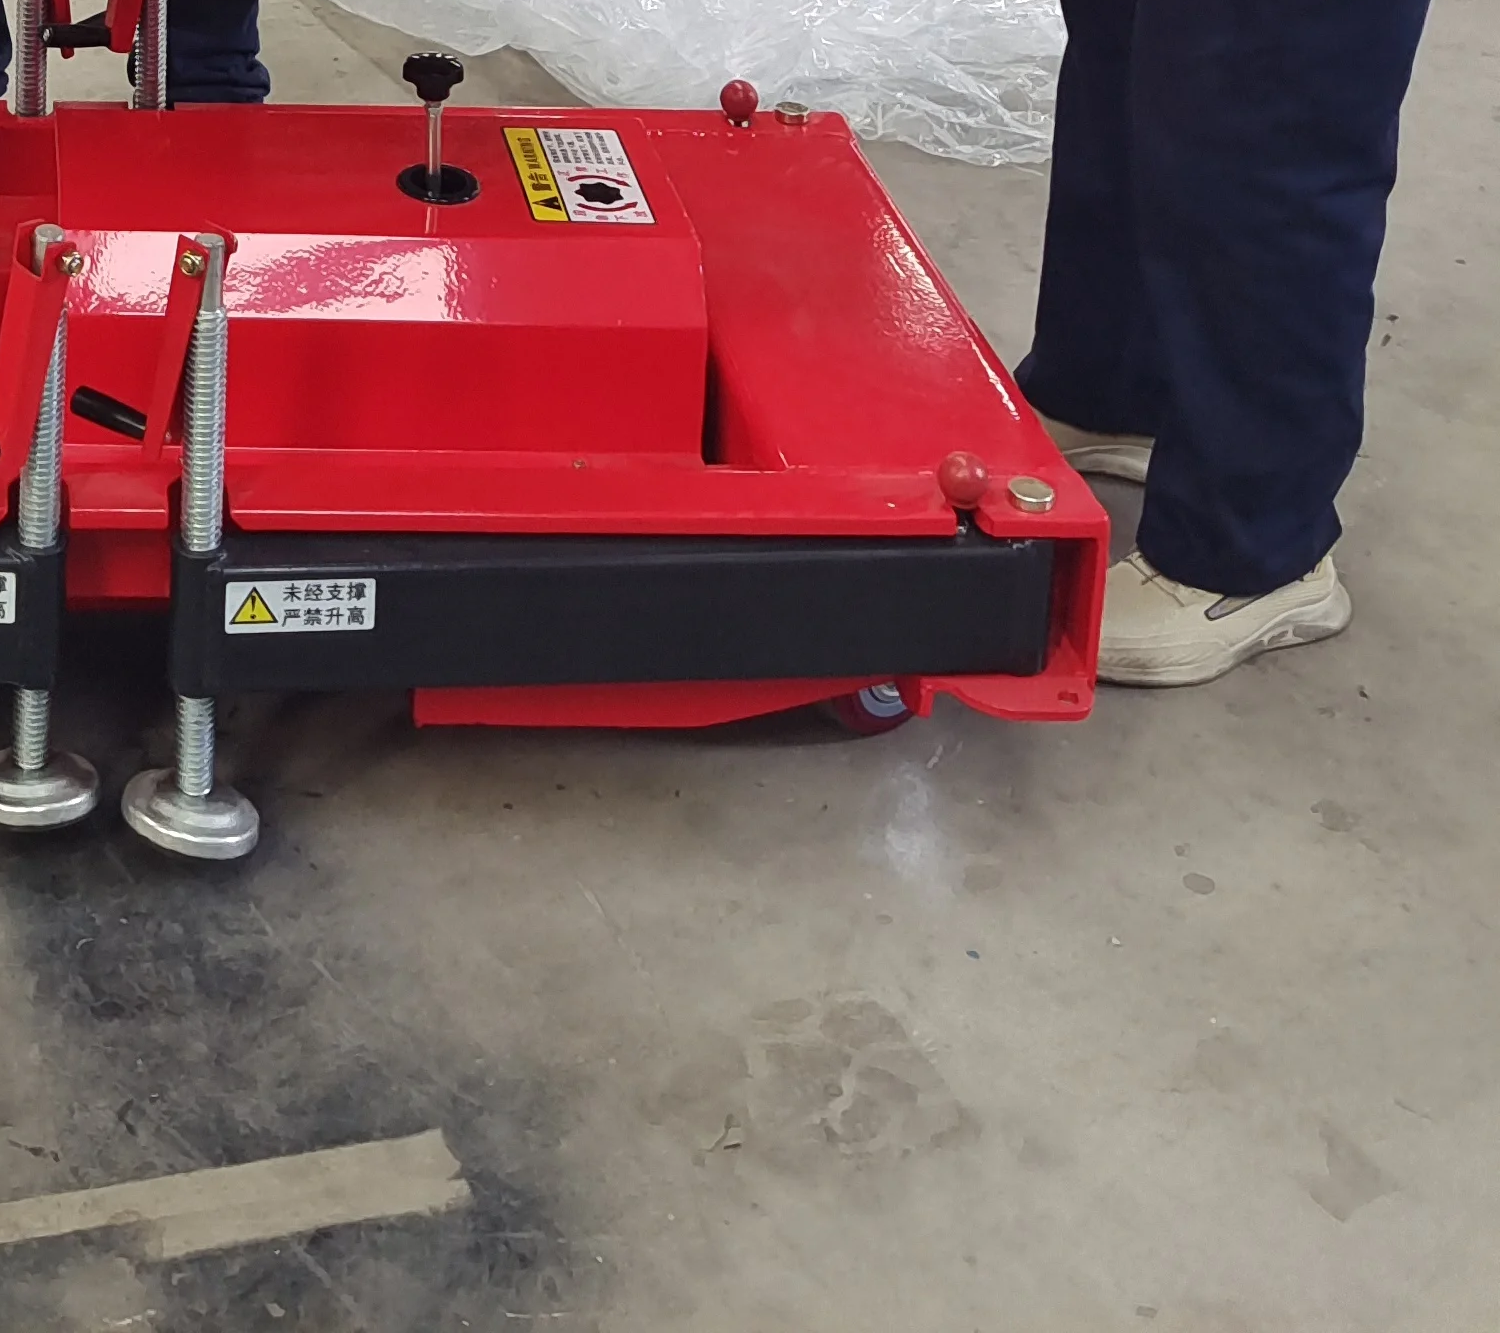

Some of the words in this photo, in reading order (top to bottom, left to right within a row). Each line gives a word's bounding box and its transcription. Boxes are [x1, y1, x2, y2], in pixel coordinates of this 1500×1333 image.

[281, 582, 368, 603] 未经支撑
[280, 606, 367, 627] 严禁升高
